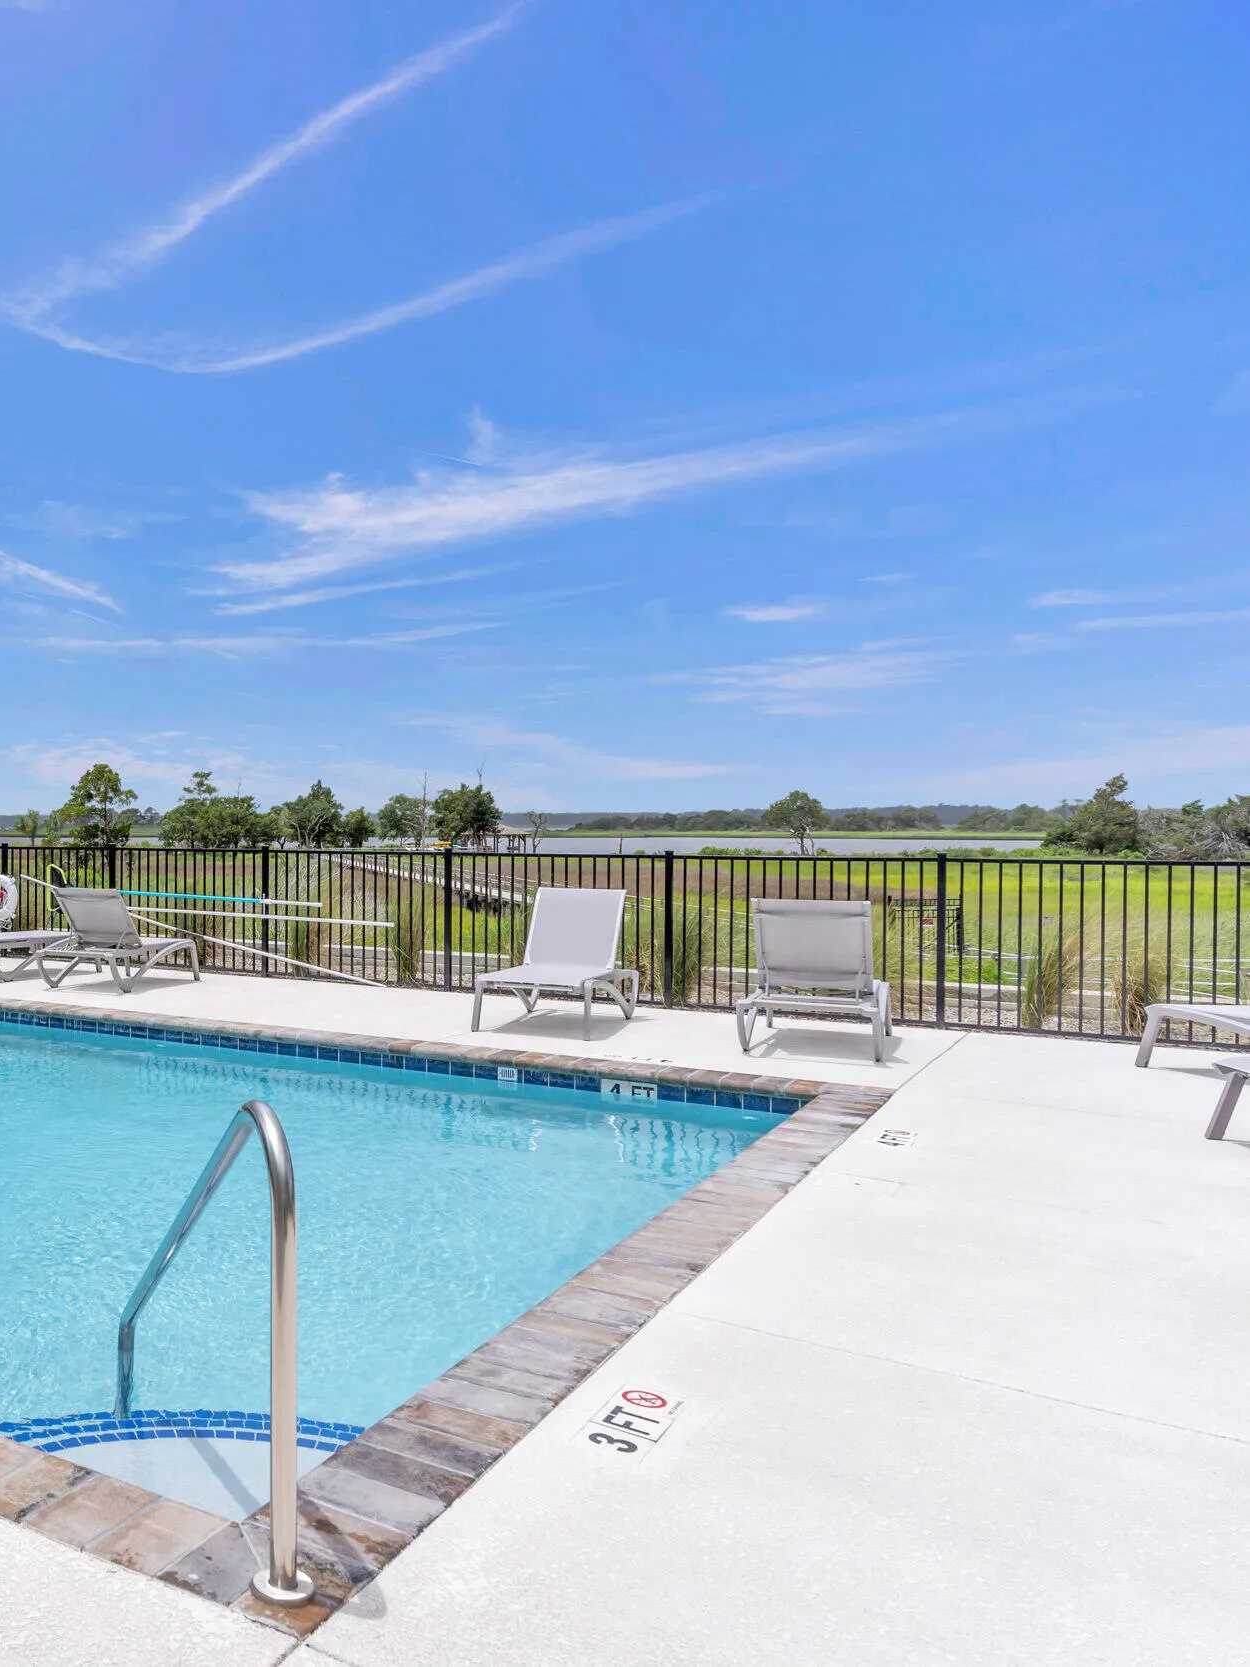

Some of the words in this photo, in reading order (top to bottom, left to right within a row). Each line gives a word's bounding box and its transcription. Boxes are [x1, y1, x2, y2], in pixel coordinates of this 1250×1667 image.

[609, 1083, 621, 1095] 4
[631, 1085, 654, 1098] FT
[602, 1405, 660, 1435] FT
[589, 1432, 638, 1453] 3
